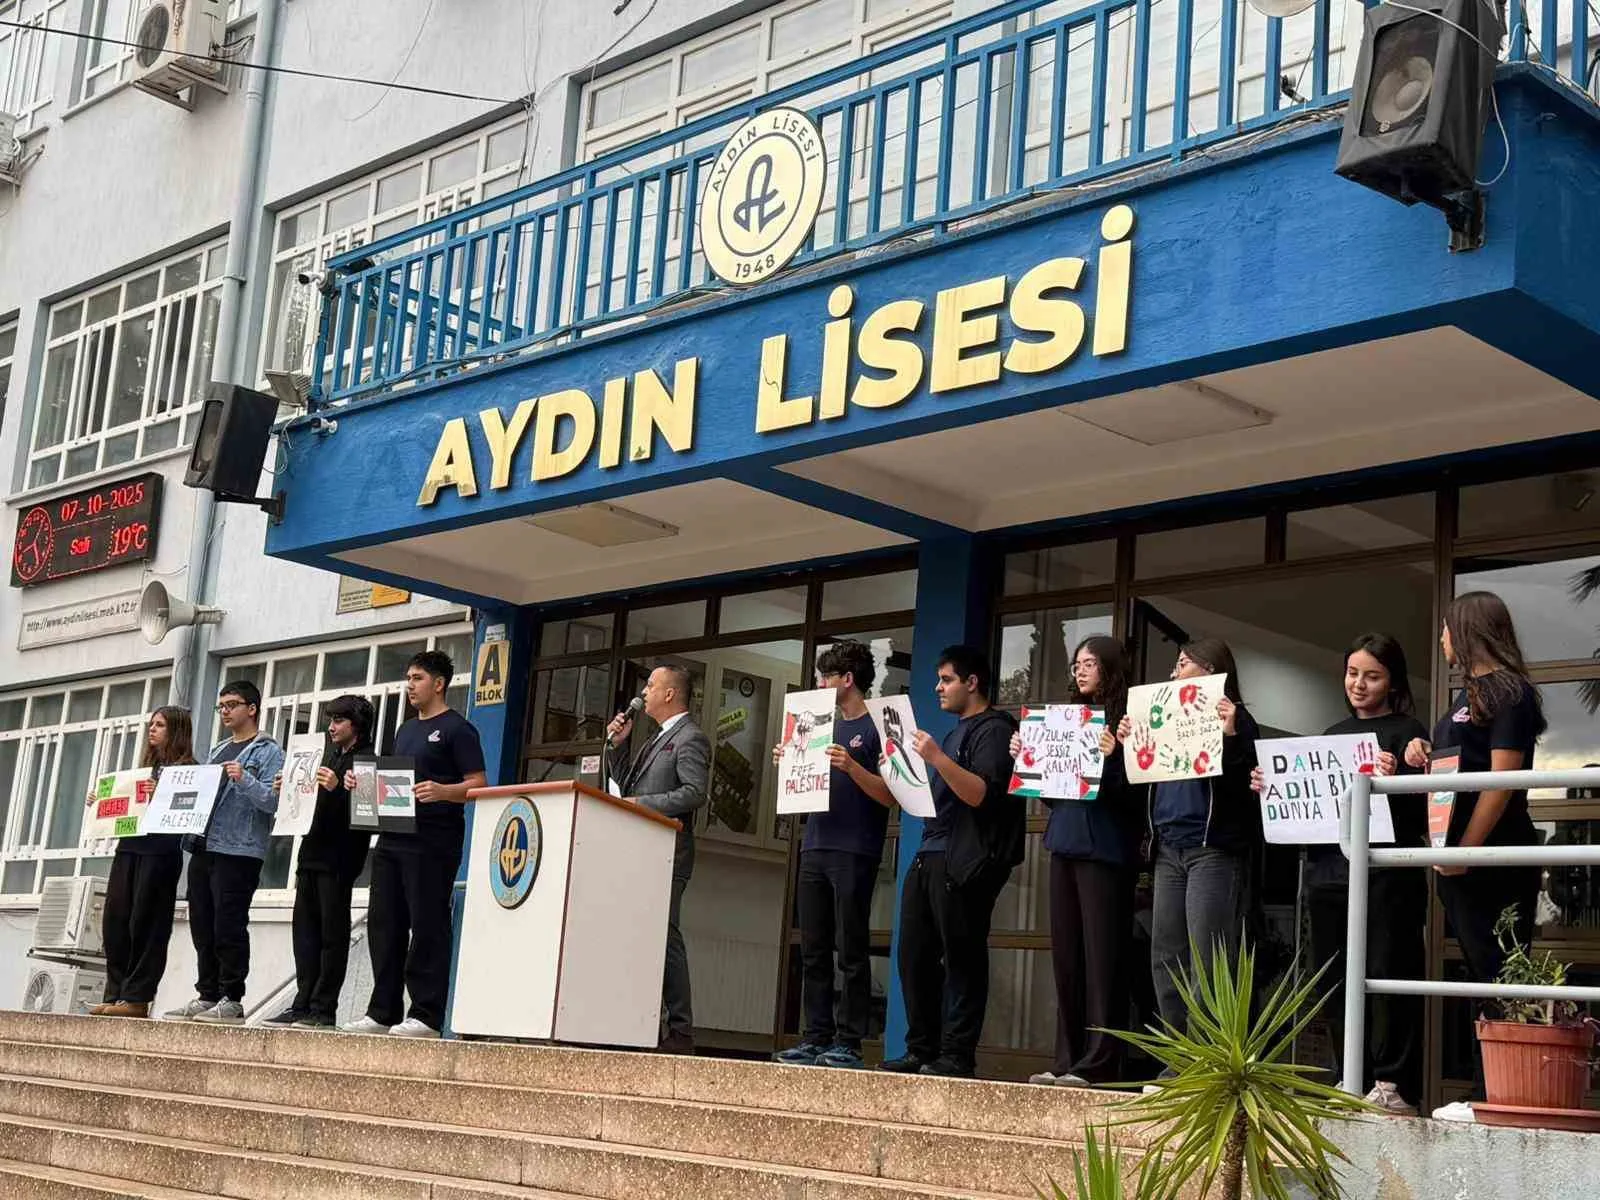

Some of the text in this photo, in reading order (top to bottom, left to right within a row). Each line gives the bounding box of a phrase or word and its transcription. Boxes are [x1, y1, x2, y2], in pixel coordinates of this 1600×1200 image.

[712, 113, 820, 192] AYDIN LİSESİ
[735, 254, 776, 278] 1948
[417, 204, 1134, 507] AYDIN LİSESİ
[61, 482, 145, 521] 07-10-2025
[480, 644, 501, 687] A
[476, 688, 503, 702] BLOK
[791, 762, 816, 777] FREE
[1272, 750, 1343, 775] DAHA
[785, 773, 829, 795] PALESTINE
[1328, 770, 1353, 797] Bİ
